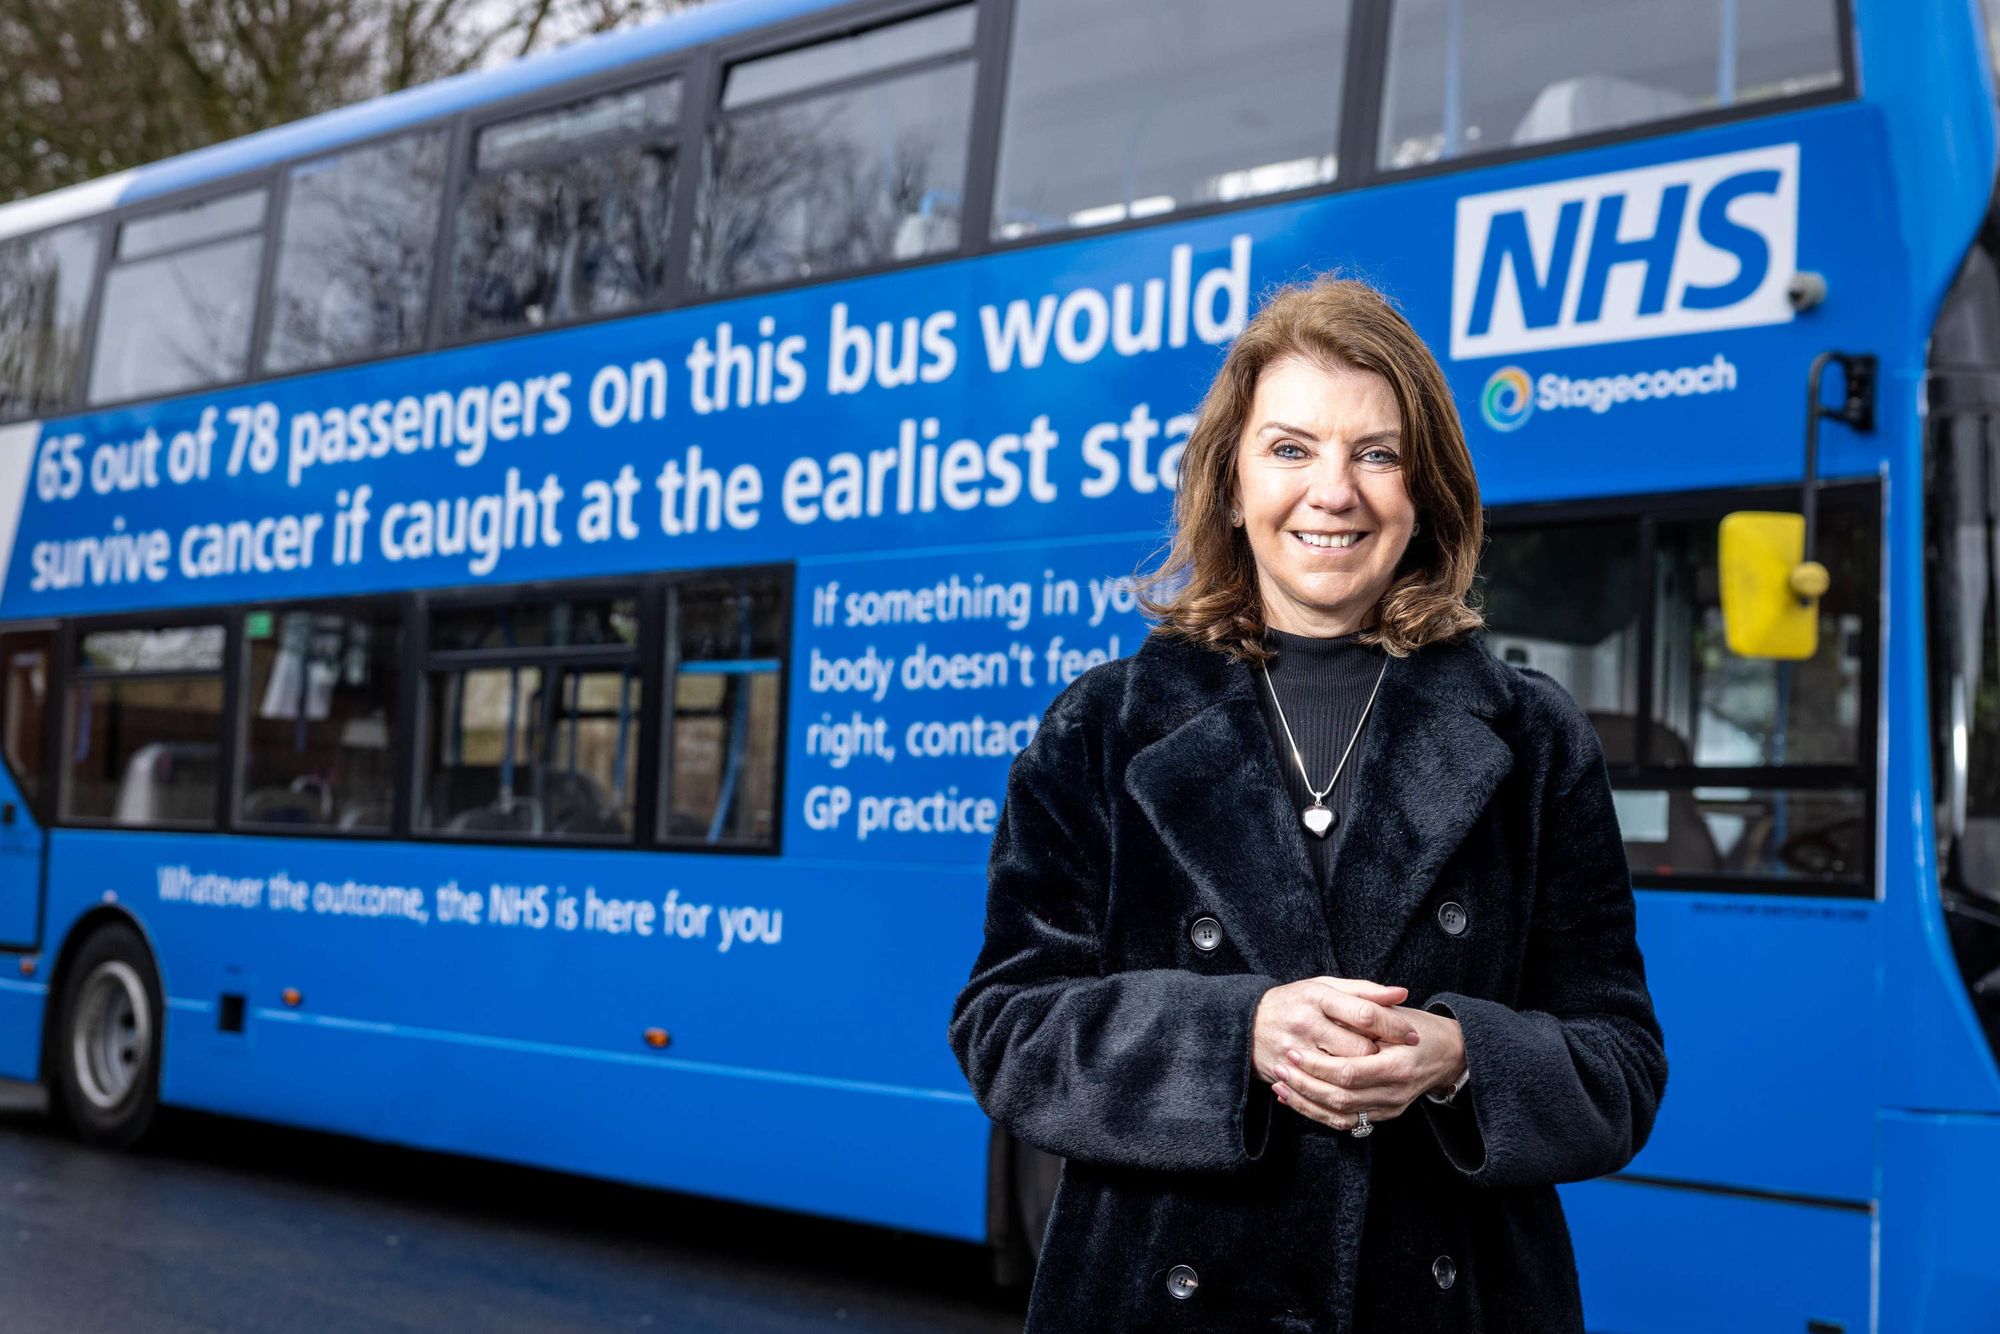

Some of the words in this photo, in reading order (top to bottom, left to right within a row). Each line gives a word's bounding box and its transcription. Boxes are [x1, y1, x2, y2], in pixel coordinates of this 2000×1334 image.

[1467, 168, 1783, 337] NHS
[35, 433, 84, 501] 65
[92, 430, 161, 493] out
[168, 407, 217, 483] of
[228, 403, 279, 475] 78
[287, 371, 571, 486] passengers
[590, 359, 666, 427] on
[687, 317, 806, 414] this
[828, 303, 956, 394] bus
[979, 234, 1252, 374] would
[1536, 353, 1737, 414] Stagecoach
[32, 516, 170, 591] survive
[181, 515, 322, 577] cancer
[333, 486, 371, 564] if
[380, 467, 564, 576] caught
[578, 466, 640, 542] at
[657, 446, 762, 535] the
[783, 416, 1058, 523] earliest
[814, 583, 838, 624] If
[845, 573, 1031, 630] something
[1043, 569, 1079, 615] in
[811, 648, 893, 700] body
[902, 644, 1033, 688] doesn't
[806, 712, 895, 768] right,
[805, 786, 850, 829] GP
[857, 787, 997, 840] practice
[158, 866, 263, 908] Whatever
[268, 873, 309, 911] the
[313, 880, 429, 924] outcome,
[437, 882, 483, 924] the
[490, 886, 548, 928] NHS
[555, 886, 579, 931] is
[584, 887, 656, 936] here
[664, 890, 711, 937] for
[718, 906, 783, 952] you
